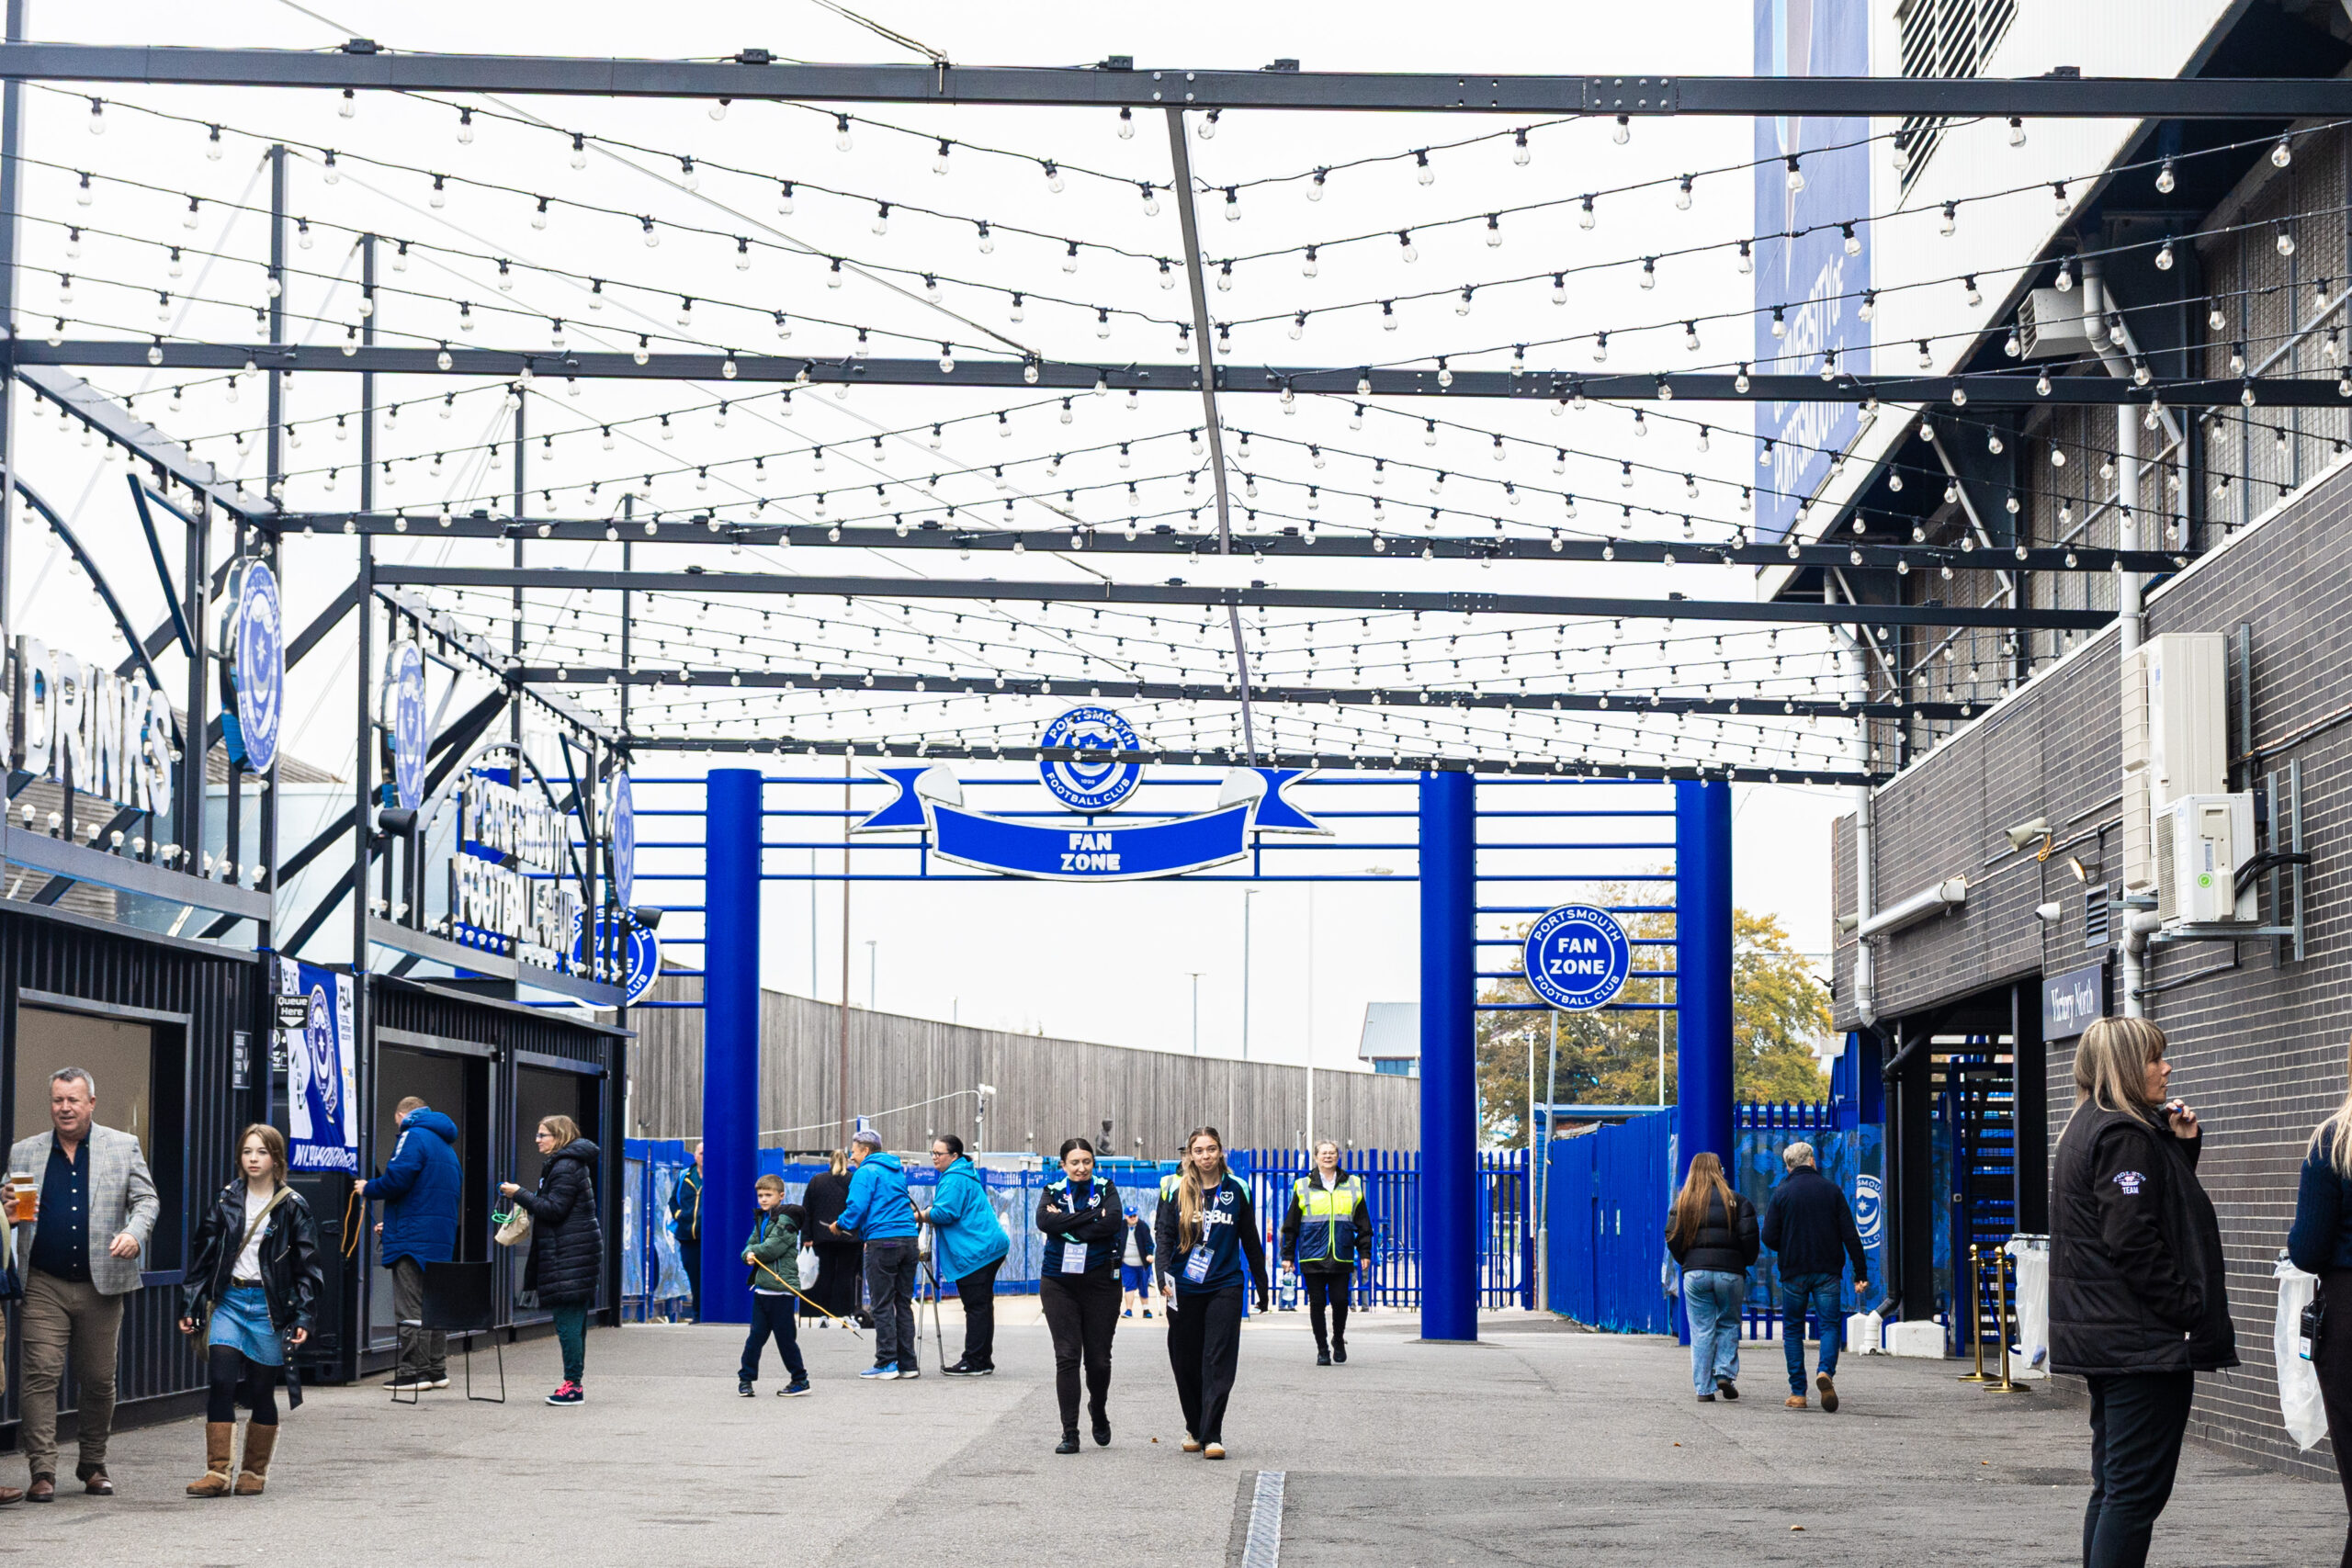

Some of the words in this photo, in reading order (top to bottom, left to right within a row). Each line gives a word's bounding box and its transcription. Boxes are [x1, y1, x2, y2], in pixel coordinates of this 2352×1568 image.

[24, 634, 173, 818] DRINKS
[1046, 772, 1102, 806] FOOTBALL
[1102, 778, 1131, 802] CLUB
[467, 774, 570, 877] PORTSMOUTH
[1069, 833, 1113, 852] FAN
[1060, 853, 1122, 873] ZONE
[458, 852, 542, 945] FOOTBALL
[1533, 908, 1622, 942] PORTSMOUTH
[1558, 937, 1597, 953] FAN
[1549, 959, 1605, 975] ZONE
[627, 974, 649, 998] LUB
[1534, 975, 1592, 1006] FOOTBALL
[1593, 975, 1621, 1000] CLUB
[277, 996, 308, 1006] Queue
[280, 1007, 304, 1016] Here
[2051, 987, 2075, 1029] Victory
[2074, 977, 2094, 1018] North
[2122, 1186, 2140, 1194] TEAM
